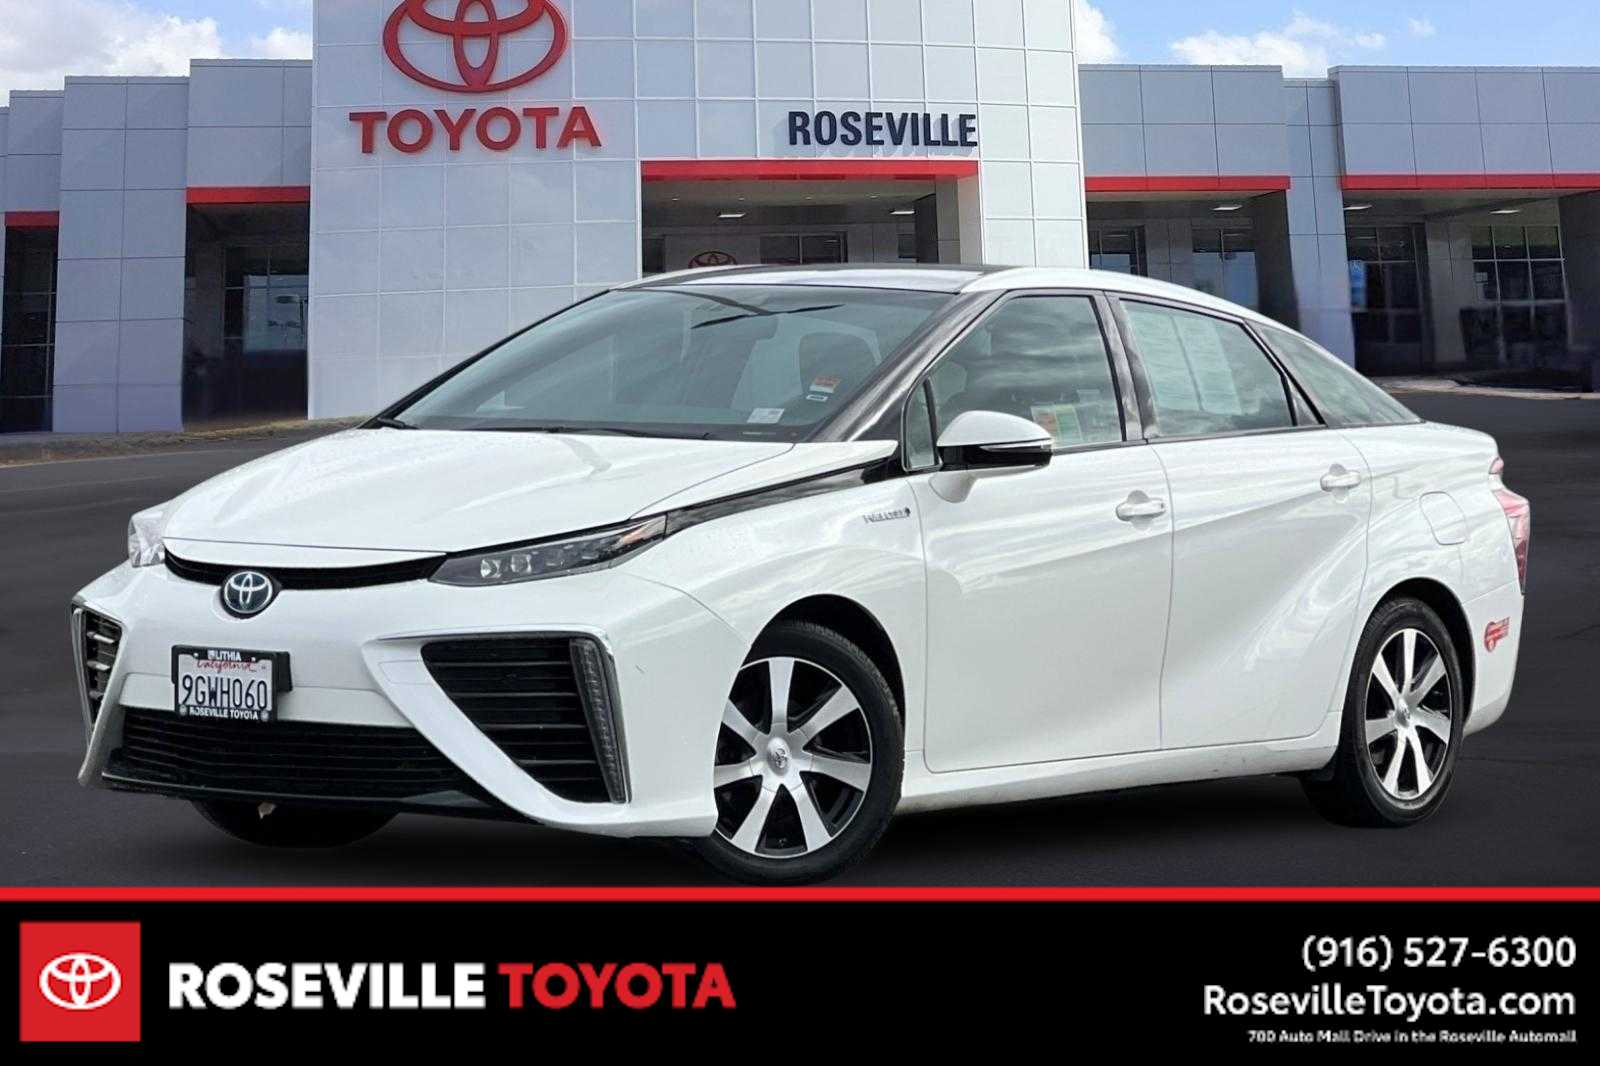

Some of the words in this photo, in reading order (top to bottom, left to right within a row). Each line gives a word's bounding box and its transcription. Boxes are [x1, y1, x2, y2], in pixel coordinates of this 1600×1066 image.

[350, 106, 602, 153] TOYOTA
[788, 110, 978, 148] ROSEVILLE
[215, 650, 242, 661] LITHIA
[182, 674, 268, 708] 9GWH060
[189, 706, 228, 718] ROSEVILLE
[229, 708, 259, 720] TOYOTA
